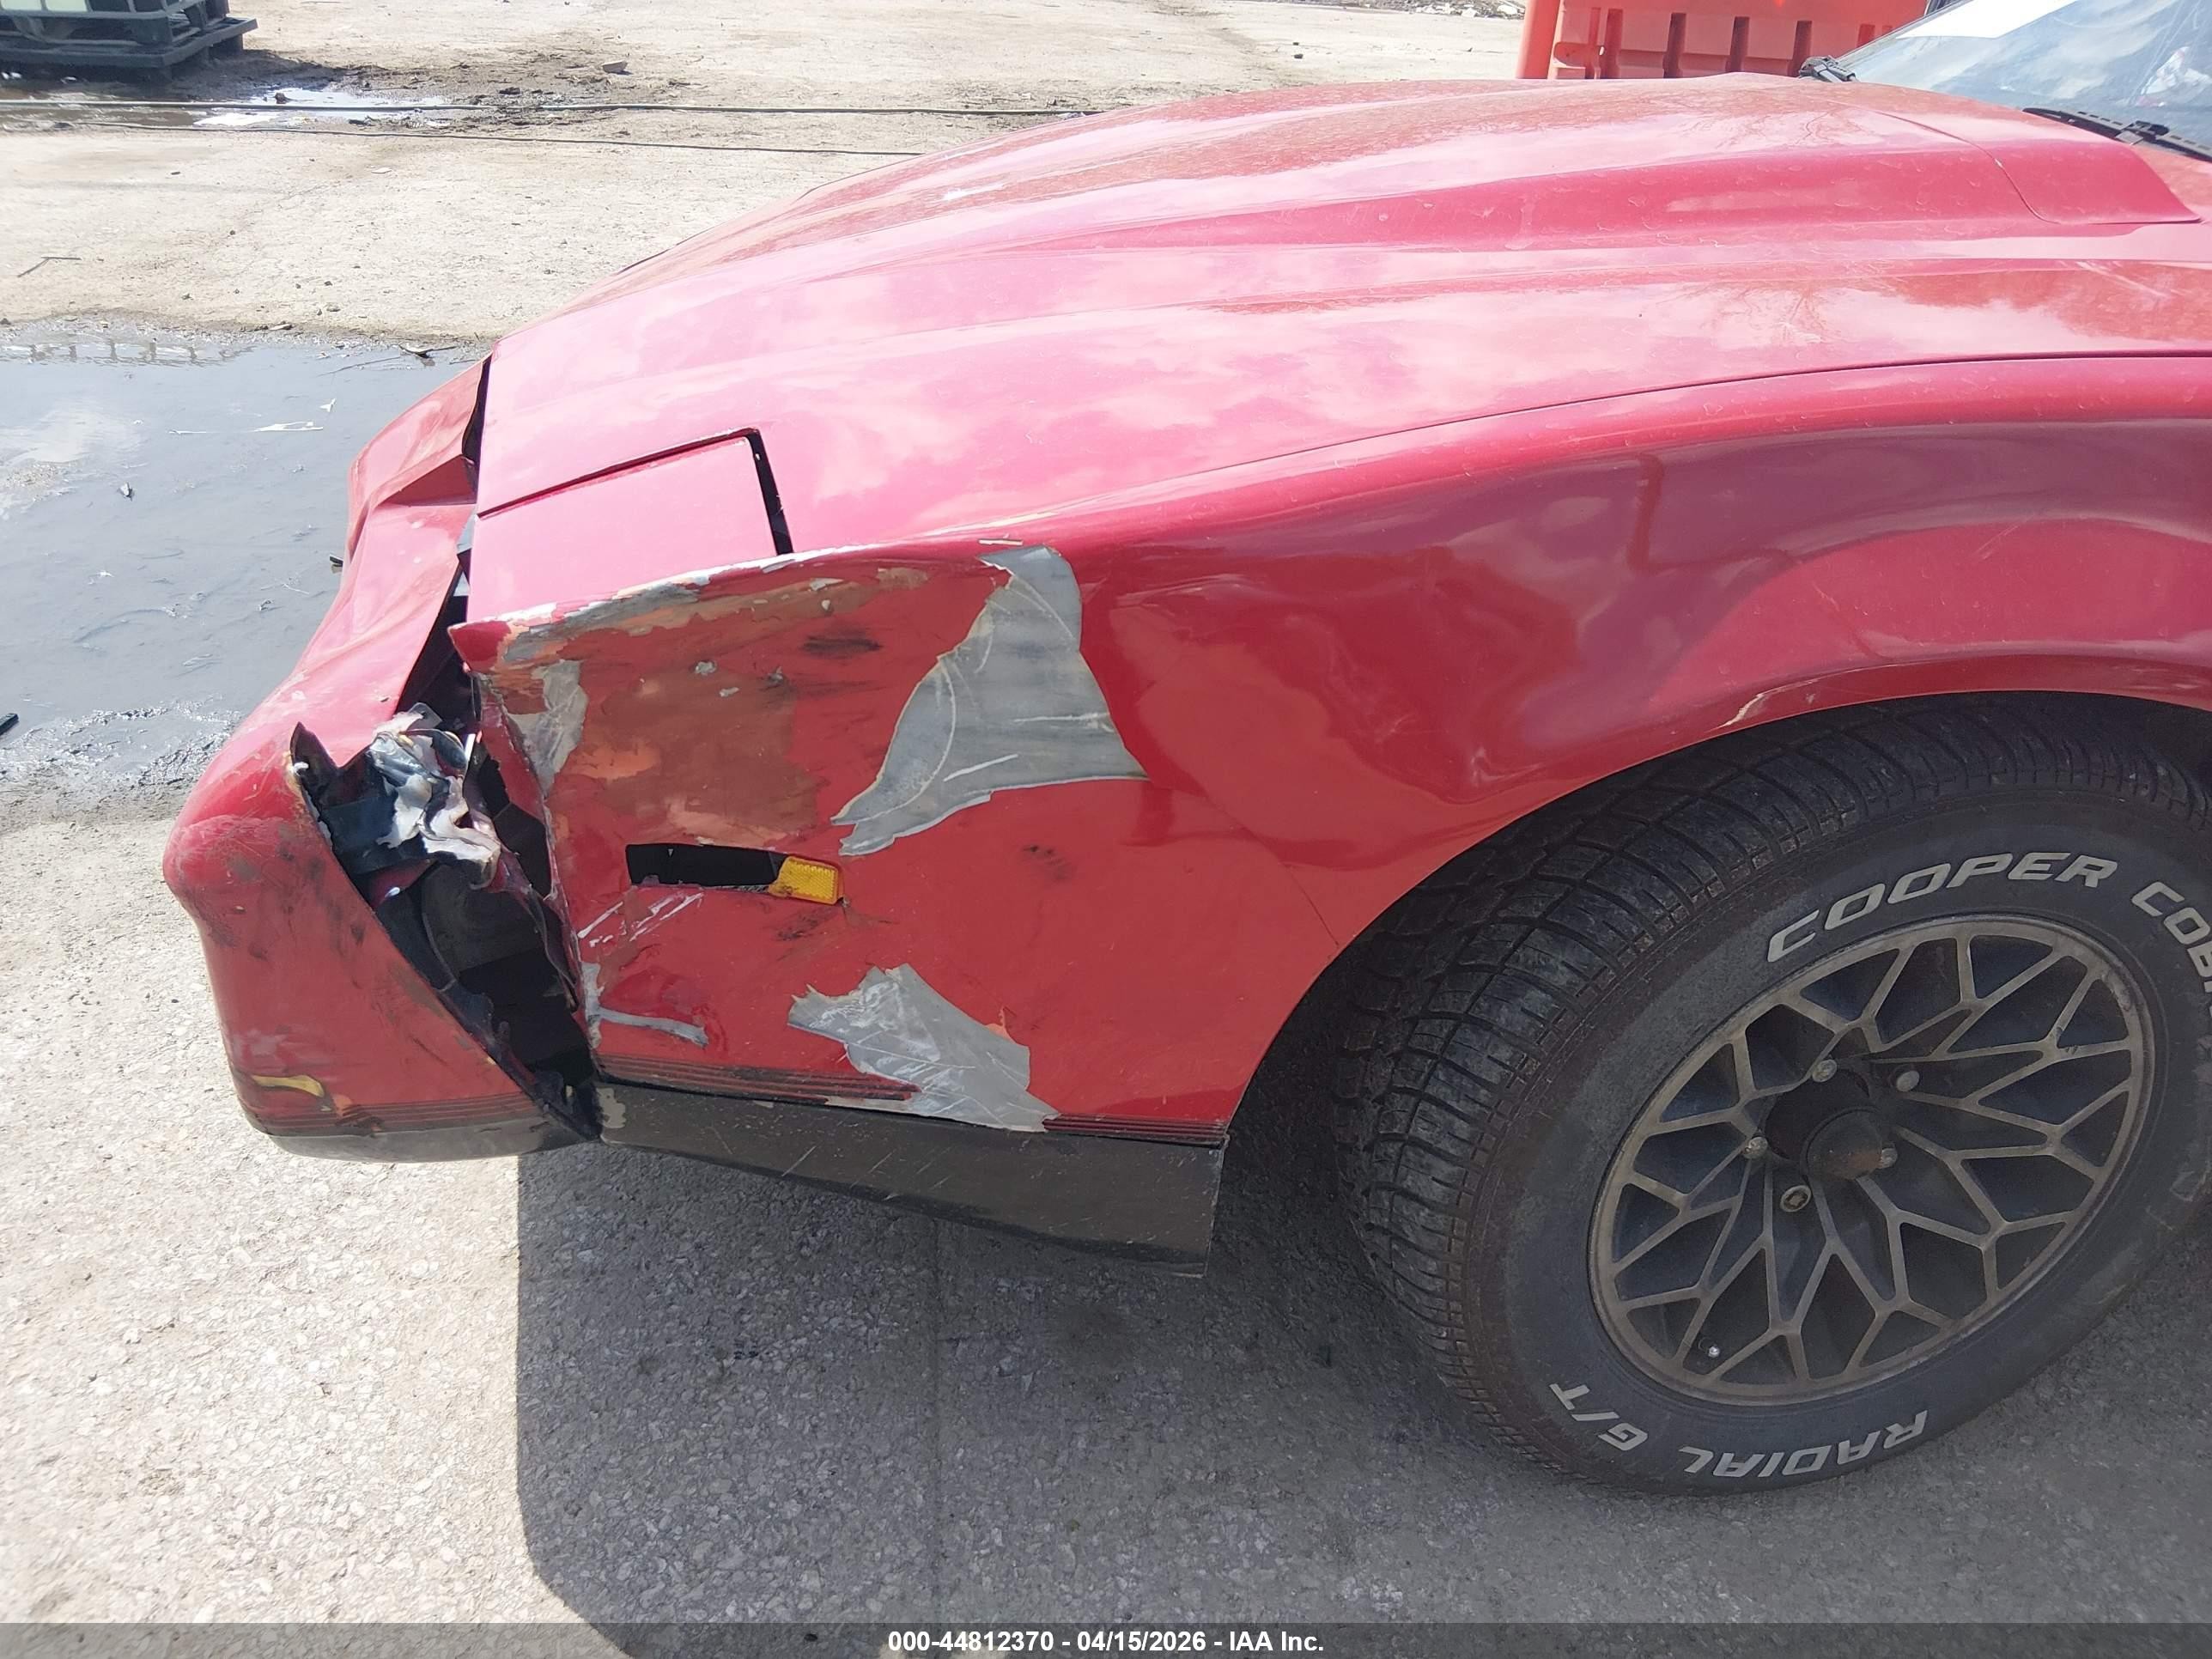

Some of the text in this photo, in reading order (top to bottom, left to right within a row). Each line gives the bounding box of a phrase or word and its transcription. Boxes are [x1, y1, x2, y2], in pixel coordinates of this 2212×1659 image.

[1767, 853, 2212, 1018] COOPER COB
[1550, 1382, 1929, 1478] RADIAL G/T
